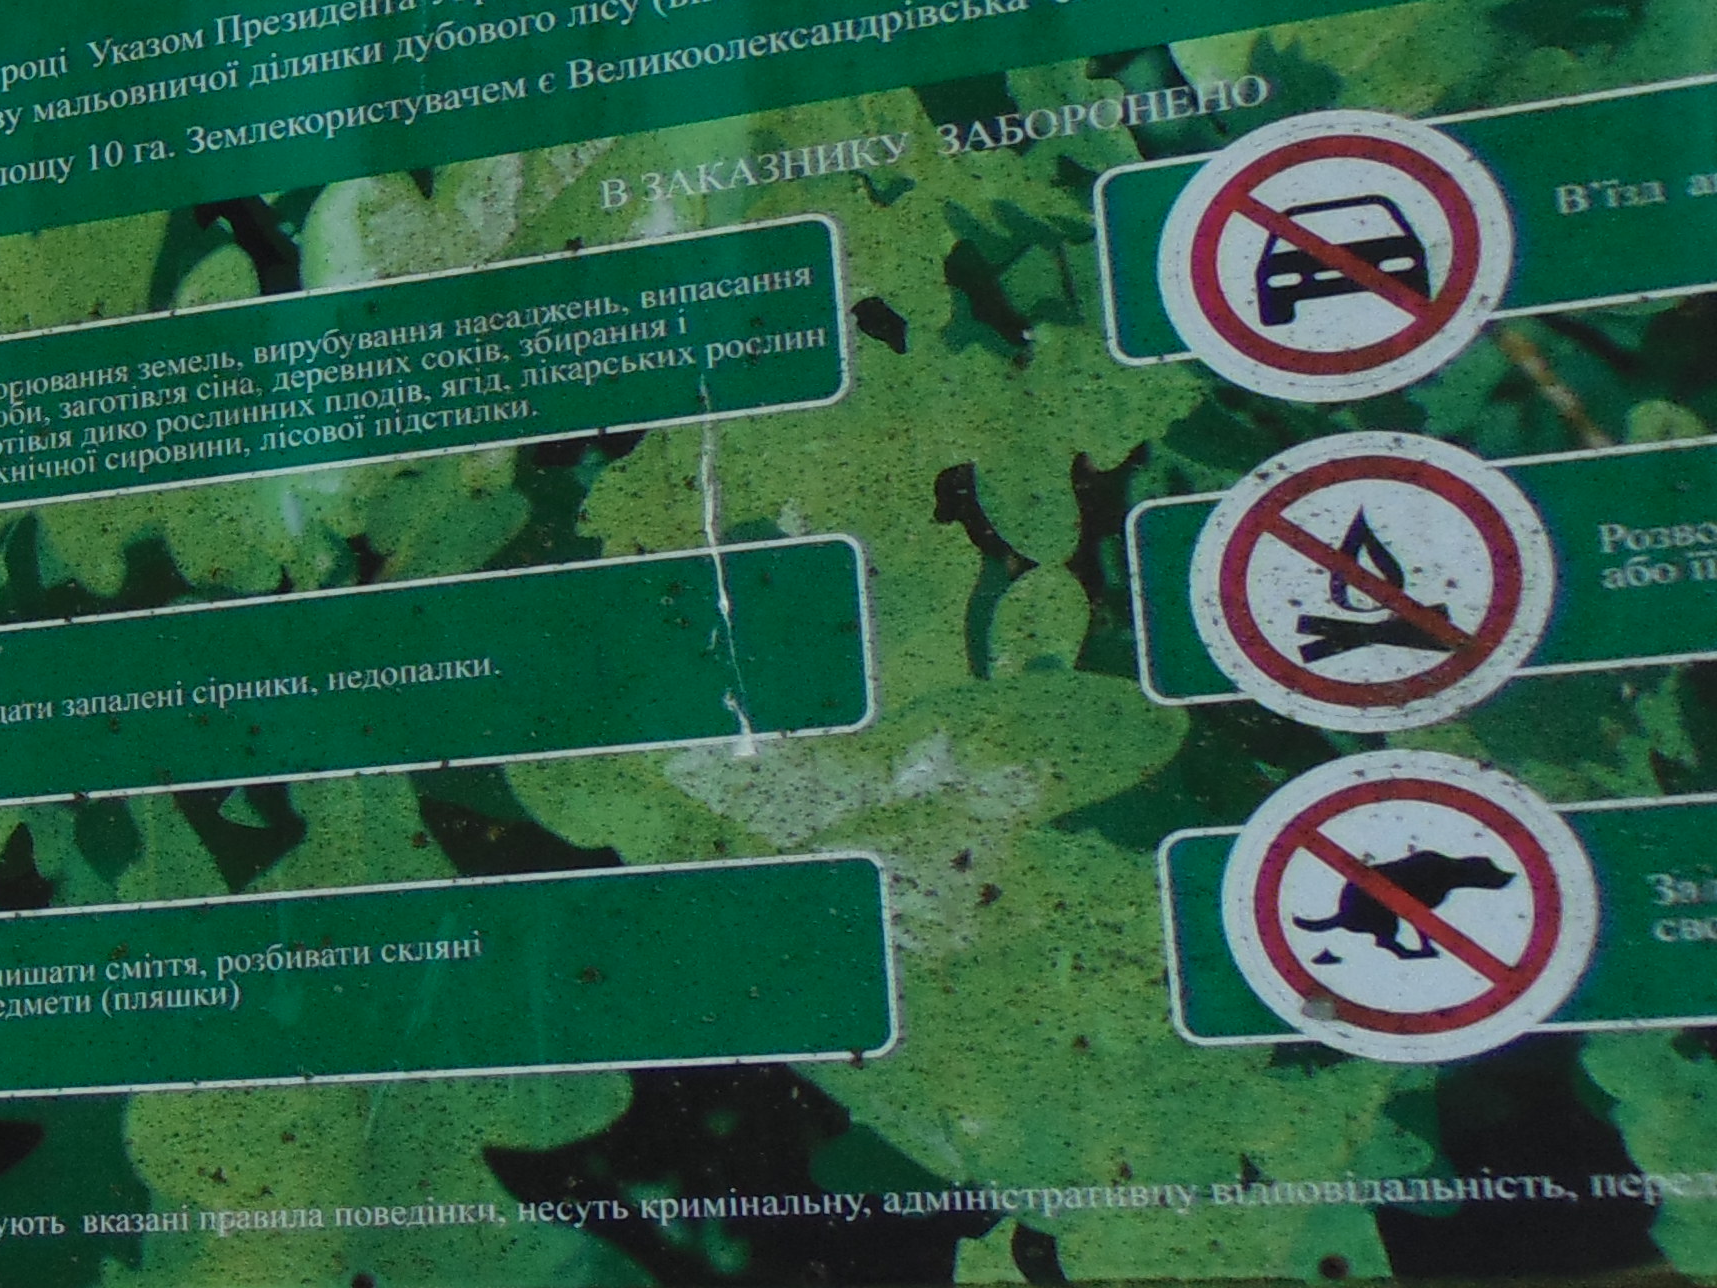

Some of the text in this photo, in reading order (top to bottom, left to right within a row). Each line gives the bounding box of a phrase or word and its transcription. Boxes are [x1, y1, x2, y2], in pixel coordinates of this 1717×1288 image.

[0, 49, 69, 94] році
[86, 28, 205, 72] Указом
[32, 66, 238, 123] мальовничої
[248, 43, 382, 89] ділянки
[393, 9, 556, 64] дубового
[88, 139, 124, 172] 10
[132, 133, 175, 166] га.
[184, 76, 527, 154] Землекористувачем
[537, 70, 556, 94] є
[600, 74, 1270, 210] В ЗАКАЗНИКУ ЗАБОРОНЕНО
[138, 350, 245, 382] земель,
[253, 319, 444, 370] вирубування
[455, 295, 630, 337] насаджень,
[640, 265, 812, 307] випасання
[60, 385, 188, 419] заготівля
[195, 373, 262, 402] сіна,
[271, 356, 412, 393] деревних
[421, 337, 511, 370] соків,
[518, 319, 668, 357] збирання
[678, 308, 689, 335] і
[81, 421, 148, 447] дико
[156, 399, 315, 437] рослинних
[324, 378, 431, 413] плодів,
[521, 346, 697, 387] лікарських
[706, 327, 827, 368] рослин
[104, 436, 251, 473] сировини,
[260, 416, 366, 452] лісової
[374, 398, 538, 438] підстилки.
[1601, 555, 1677, 589] або
[62, 680, 183, 718] запалені
[191, 675, 318, 710] сірники,
[328, 656, 502, 692] недопалки.
[104, 953, 208, 983] сміття,
[216, 944, 370, 979] розбивати
[380, 931, 482, 964] скляні
[101, 980, 243, 1017] (пляшки)
[82, 1205, 190, 1234] вказані
[199, 1207, 324, 1239] правила
[334, 1195, 505, 1228] поведінки,
[516, 1197, 628, 1228] несуть
[640, 1188, 871, 1225] кримінальну,
[883, 1181, 1197, 1217] адміністративну
[1211, 1167, 1577, 1207] відповідальність,
